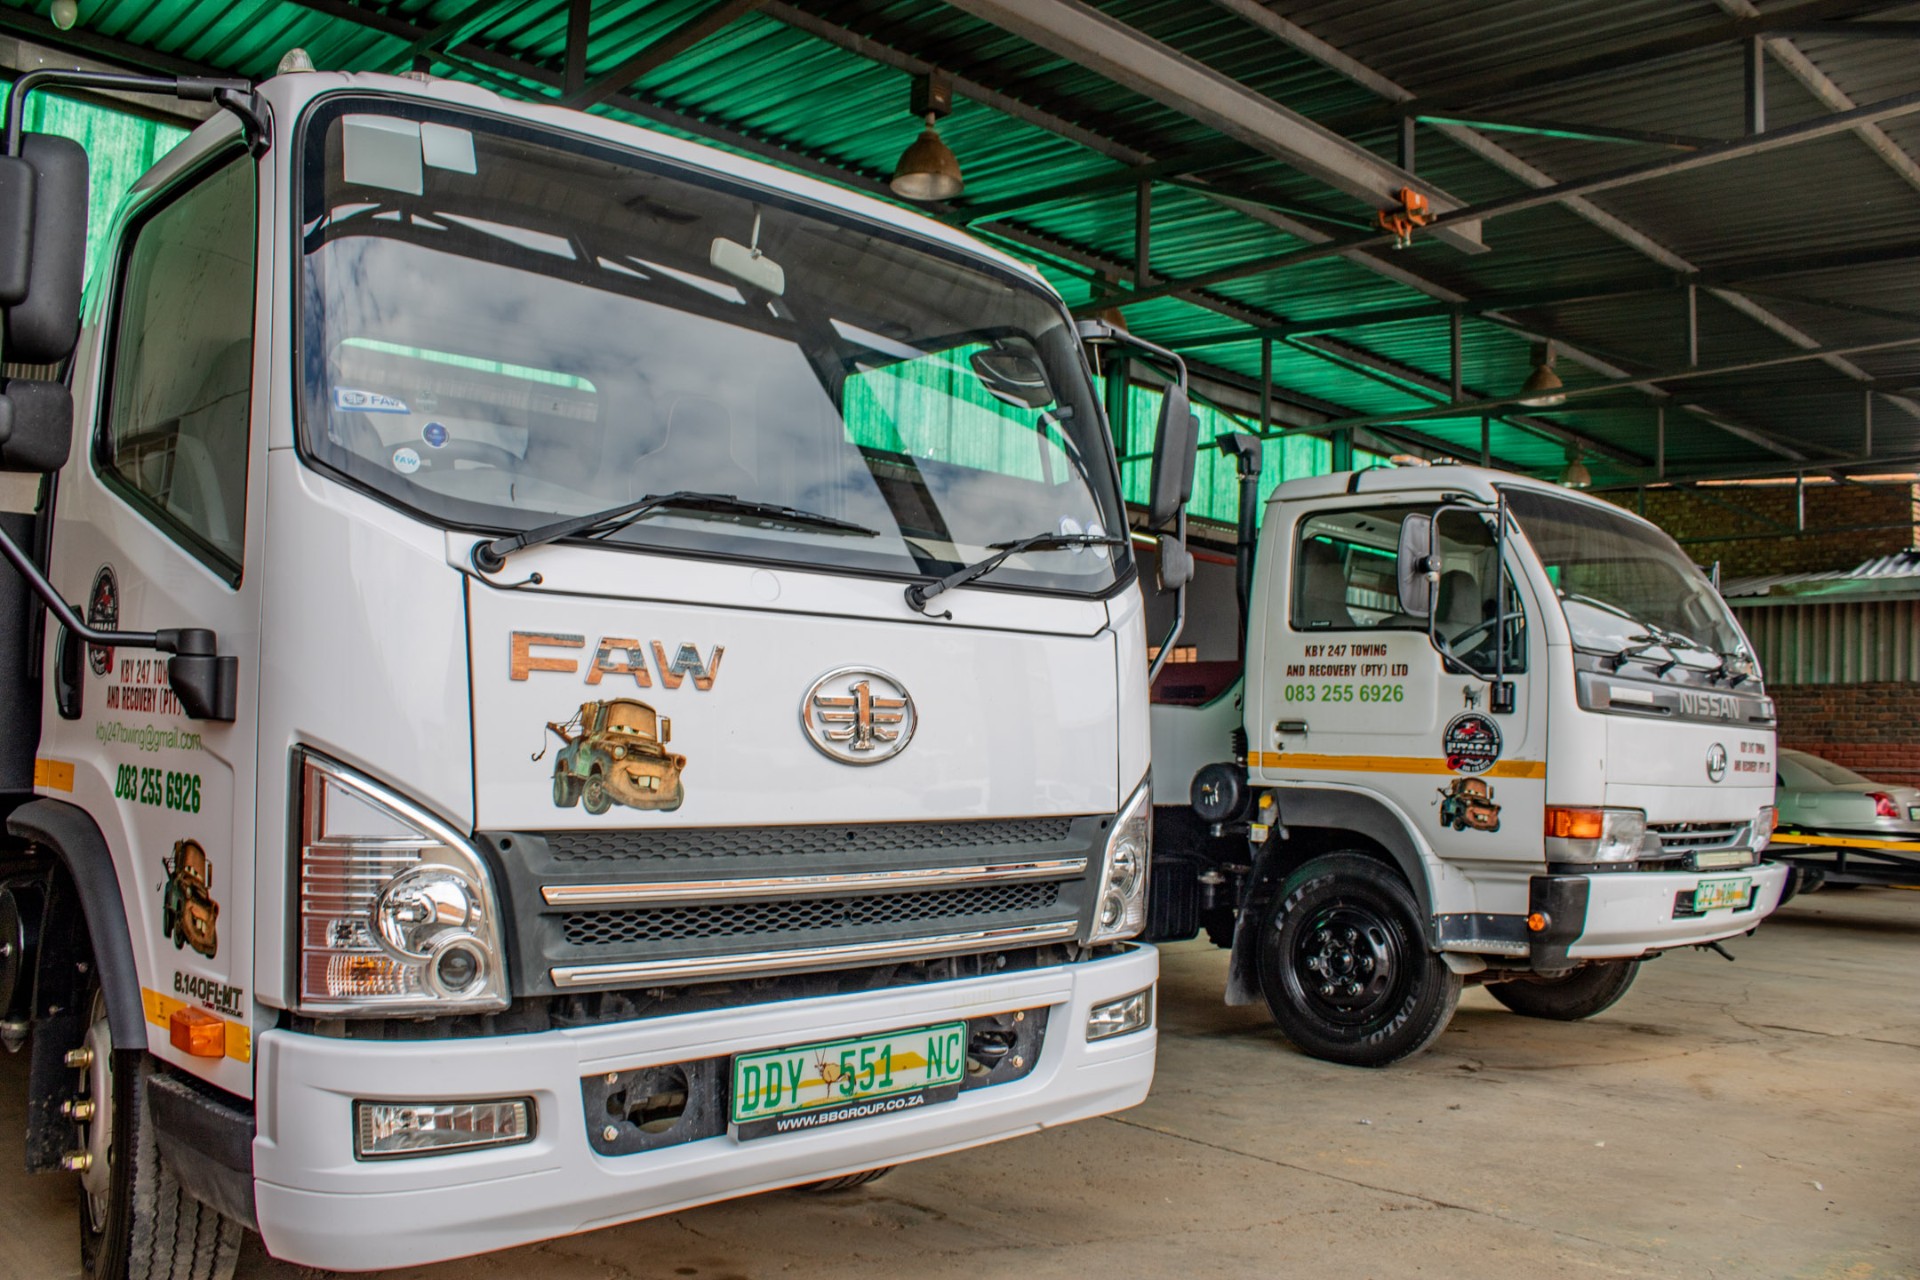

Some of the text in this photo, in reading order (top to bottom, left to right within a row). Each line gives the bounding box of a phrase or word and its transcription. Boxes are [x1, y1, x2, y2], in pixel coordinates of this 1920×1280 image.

[394, 454, 417, 466] FAW
[509, 629, 726, 692] FAW
[1304, 643, 1387, 657] KBY 247 TOWING
[120, 659, 134, 683] KBY
[136, 659, 150, 684] 247
[1286, 663, 1409, 677] AND RECOVERY (PTY) LTD
[106, 685, 120, 710] AND
[122, 686, 158, 713] RECOVERY
[1284, 684, 1404, 702] 083 255 6926
[1679, 691, 1740, 720] NISSAN
[115, 763, 201, 814] 083 255 6926
[740, 1032, 960, 1113] DDY 551 NC
[776, 1094, 925, 1132] WWW.BBGROUP.CO.ZA
